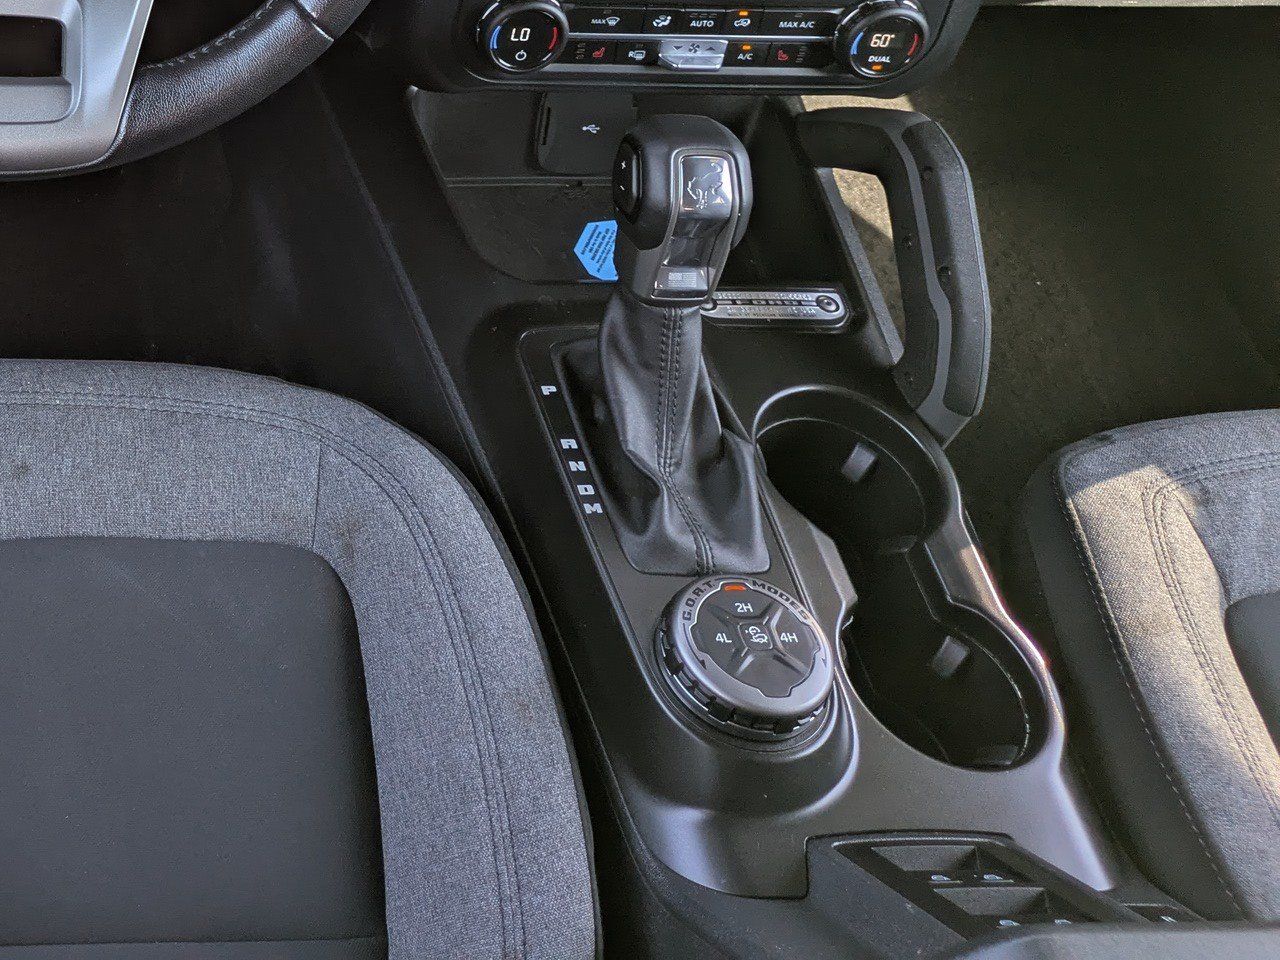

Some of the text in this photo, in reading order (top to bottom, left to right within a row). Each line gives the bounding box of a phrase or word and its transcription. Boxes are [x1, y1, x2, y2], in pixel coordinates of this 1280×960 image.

[590, 18, 607, 26] MAX
[689, 20, 715, 28] AUTO
[778, 20, 815, 29] MAX A/C
[511, 27, 531, 42] LO
[737, 53, 754, 61] A/C
[868, 54, 890, 63] DUAL
[540, 385, 557, 396] P
[568, 460, 586, 472] N
[576, 484, 595, 496] D
[583, 502, 603, 515] M
[752, 579, 809, 621] MODES
[734, 601, 754, 613] 2H
[715, 632, 799, 643] 4L 4H
